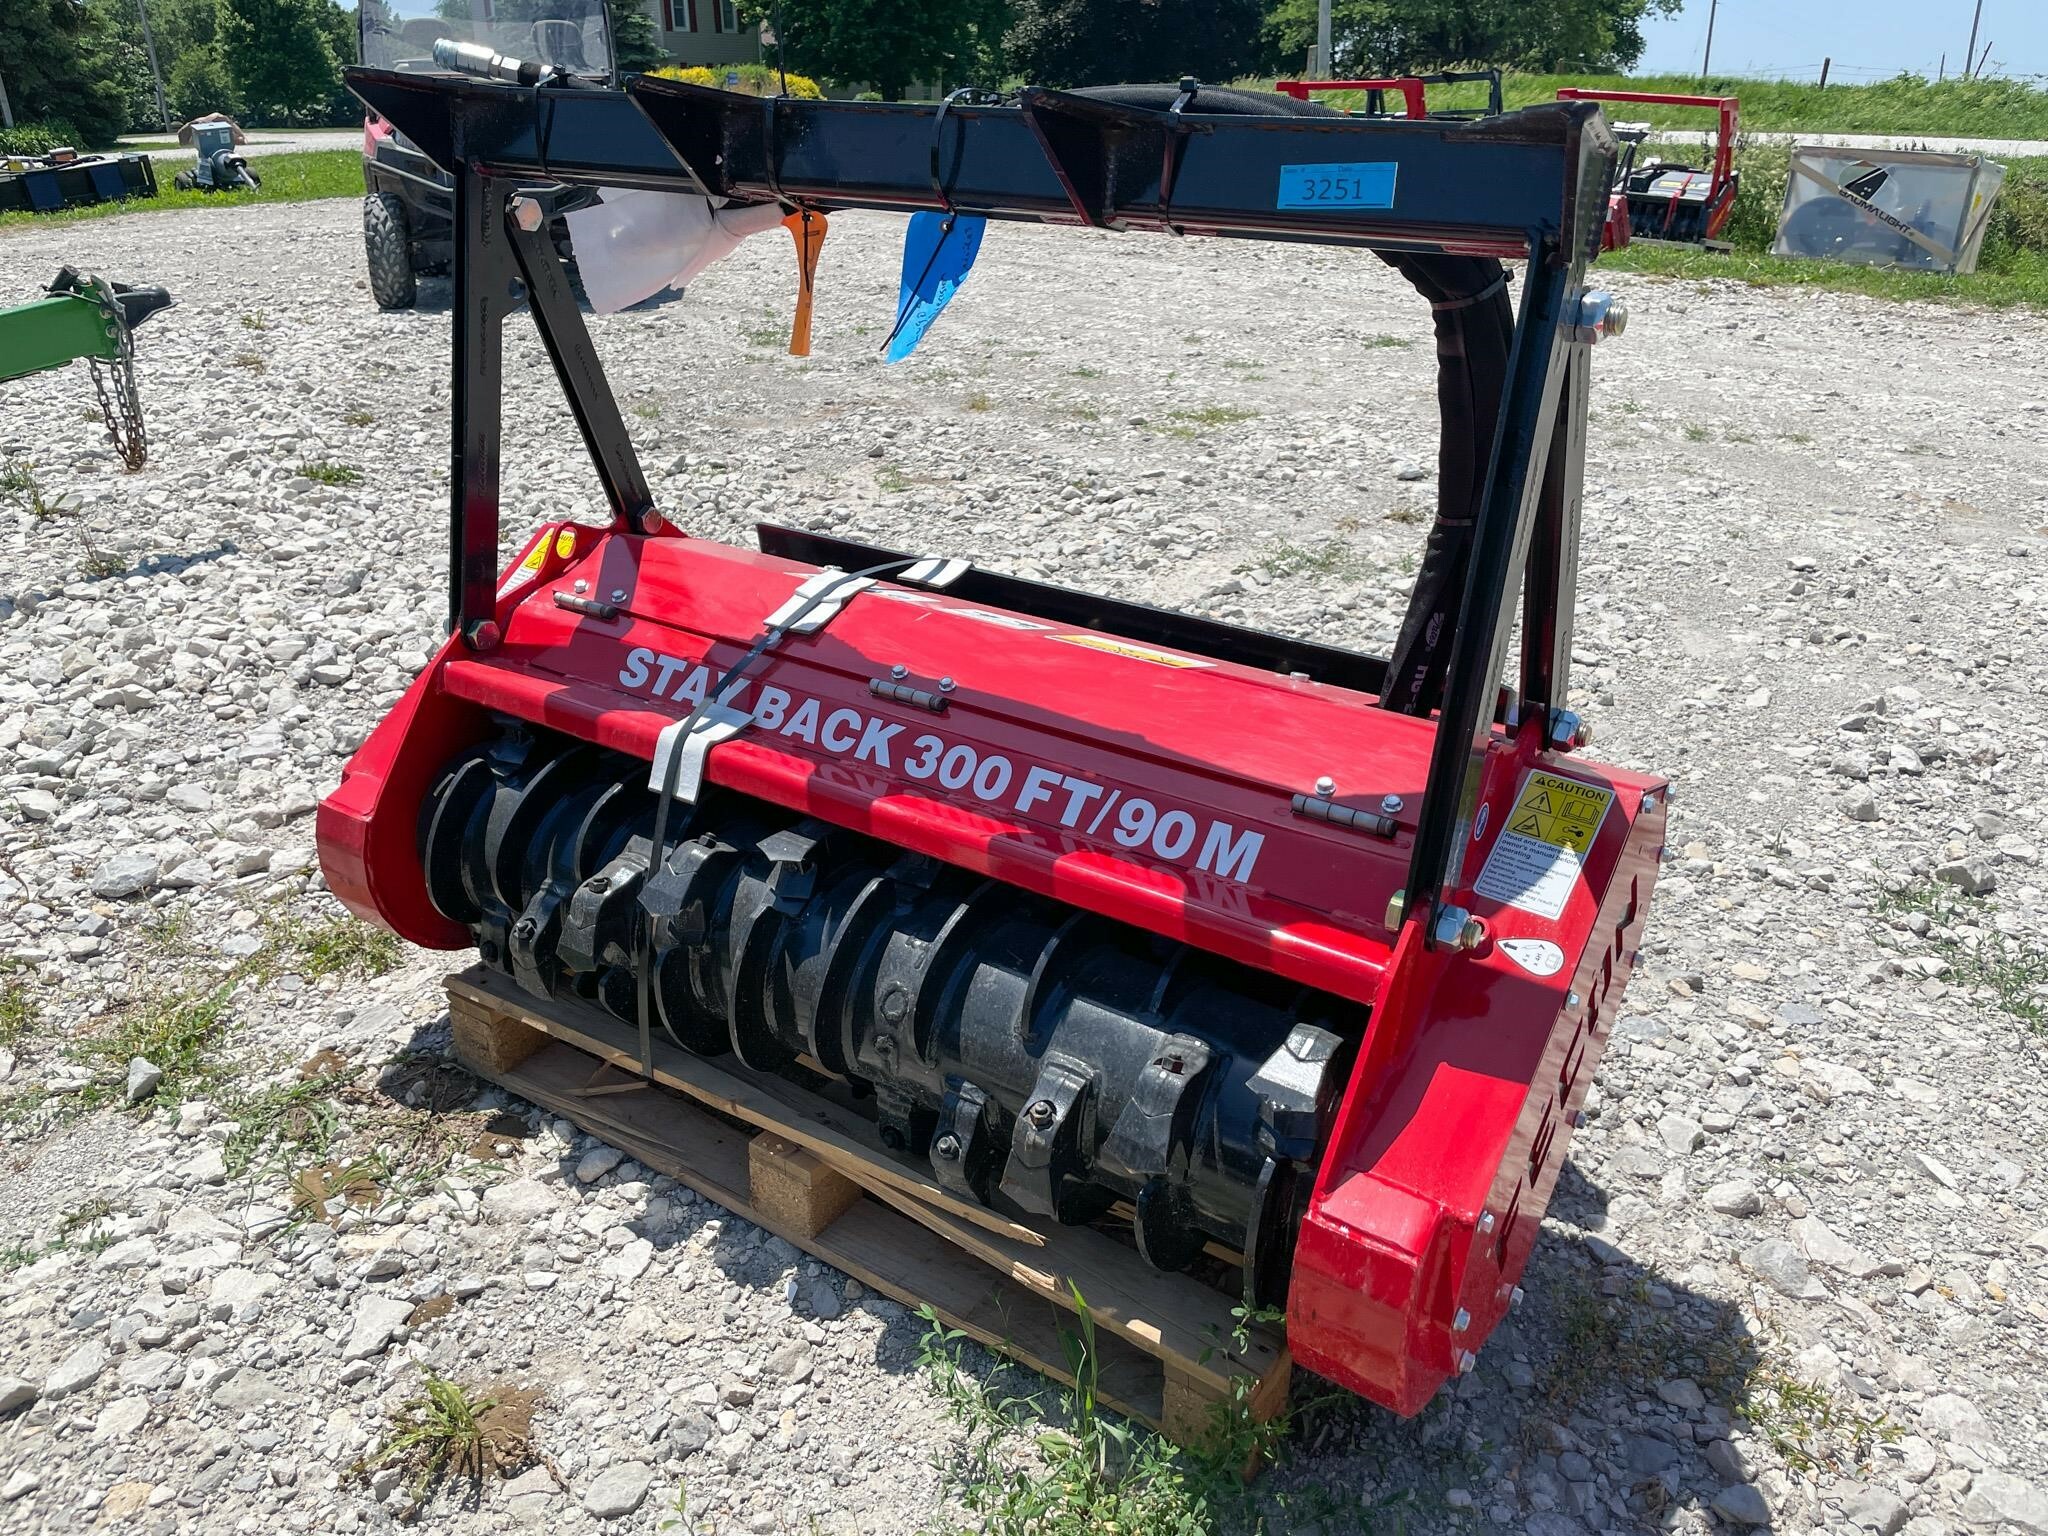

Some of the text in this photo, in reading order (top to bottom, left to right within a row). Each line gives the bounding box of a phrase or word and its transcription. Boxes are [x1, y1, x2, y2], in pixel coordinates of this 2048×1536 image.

[1302, 178, 1363, 200] 3251
[619, 648, 1266, 884] STAY BACK 300 FT/90 M
[1546, 779, 1606, 802] CAUTION
[1500, 838, 1578, 866] owner's manual before
[1503, 832, 1577, 859] Read and understand
